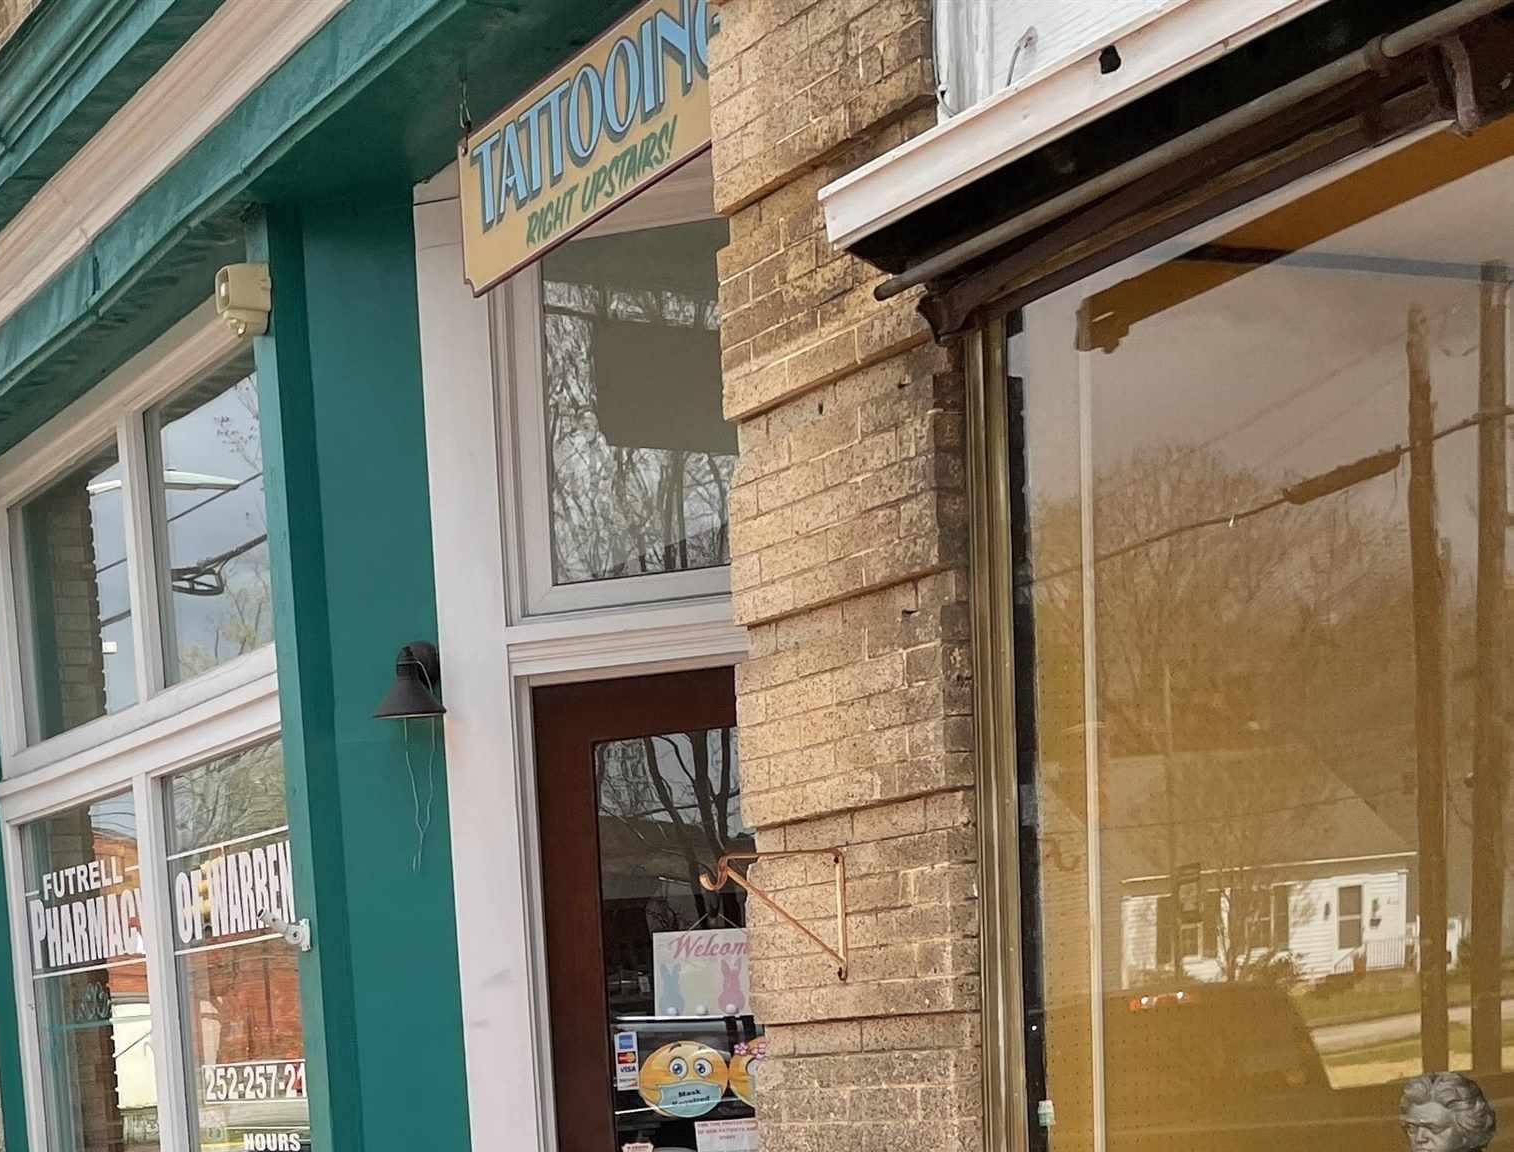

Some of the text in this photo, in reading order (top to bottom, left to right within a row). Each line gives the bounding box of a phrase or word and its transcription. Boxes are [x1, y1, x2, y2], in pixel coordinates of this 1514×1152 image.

[527, 115, 677, 247] RIGHT UPSTAIRS!
[42, 856, 124, 901] FUTRELL
[29, 888, 145, 969] PHARMAC
[678, 1088, 701, 1097] Mask
[243, 1133, 302, 1151] HOURS
